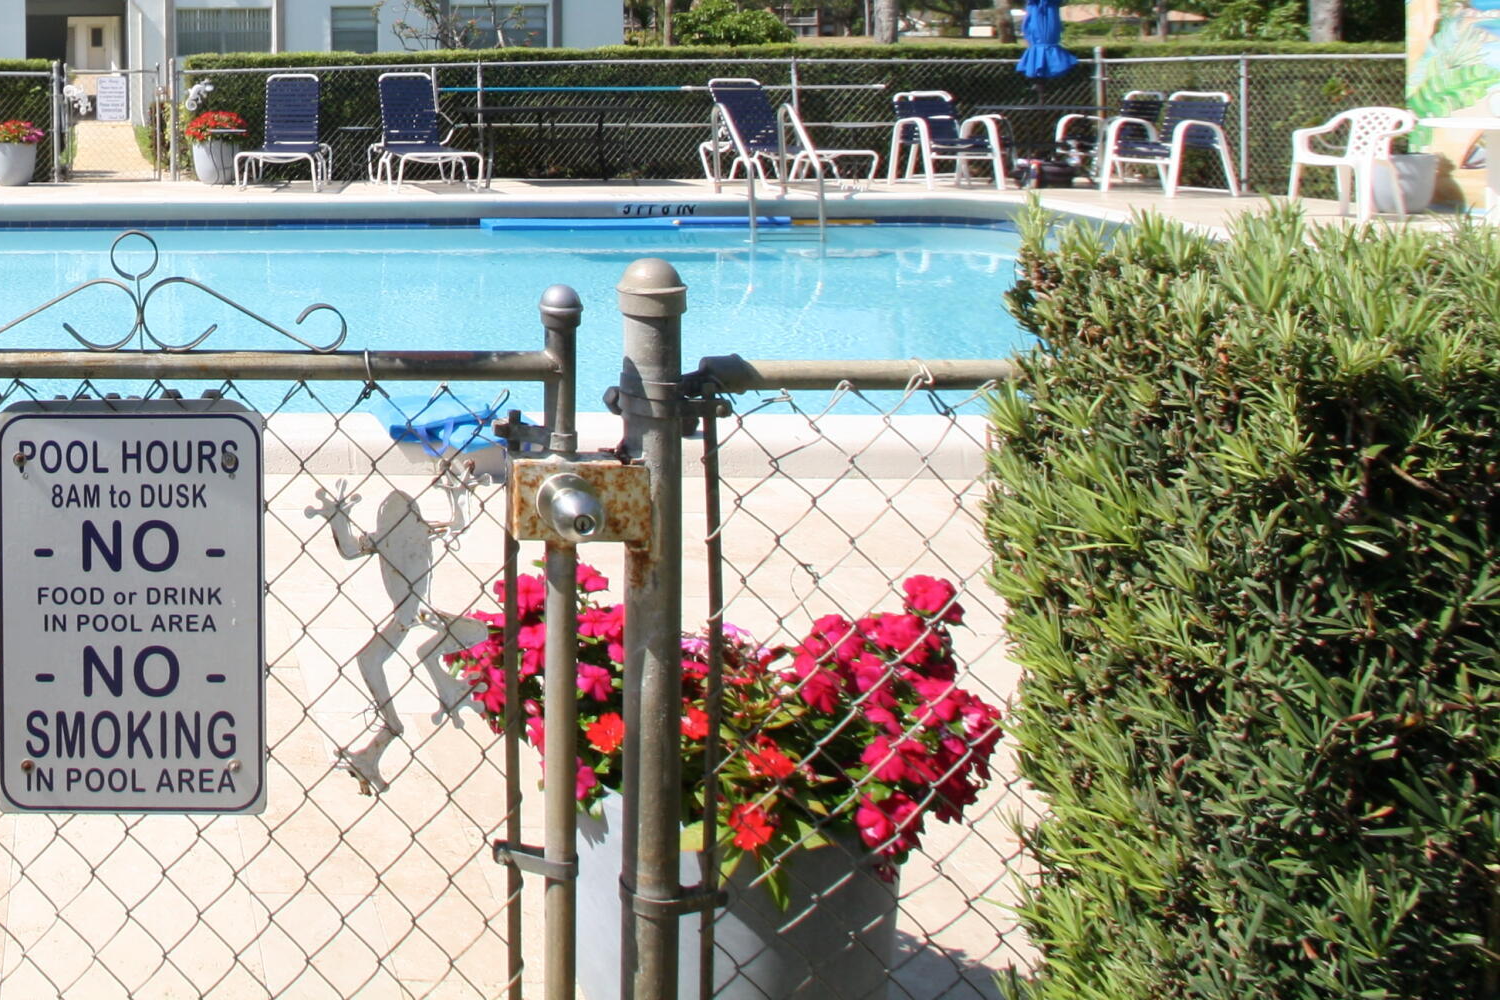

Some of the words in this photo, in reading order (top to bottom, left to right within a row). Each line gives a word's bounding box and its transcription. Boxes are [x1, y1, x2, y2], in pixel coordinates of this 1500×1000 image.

[18, 440, 109, 474] POOL
[122, 440, 239, 474] HOURS
[51, 484, 101, 508] 8AM
[109, 486, 131, 508] to
[140, 484, 207, 508] DUSK
[81, 520, 180, 573] NO
[37, 588, 104, 605] FOOD
[113, 591, 137, 605] or
[146, 587, 222, 605] DRINK
[44, 615, 68, 632] IN
[77, 614, 142, 632] POOL
[151, 614, 217, 632] AREA
[83, 645, 180, 697] NO
[25, 711, 237, 759] SMOKING
[26, 768, 54, 793] IN
[66, 768, 145, 793] POOL
[156, 768, 236, 793] AREA
